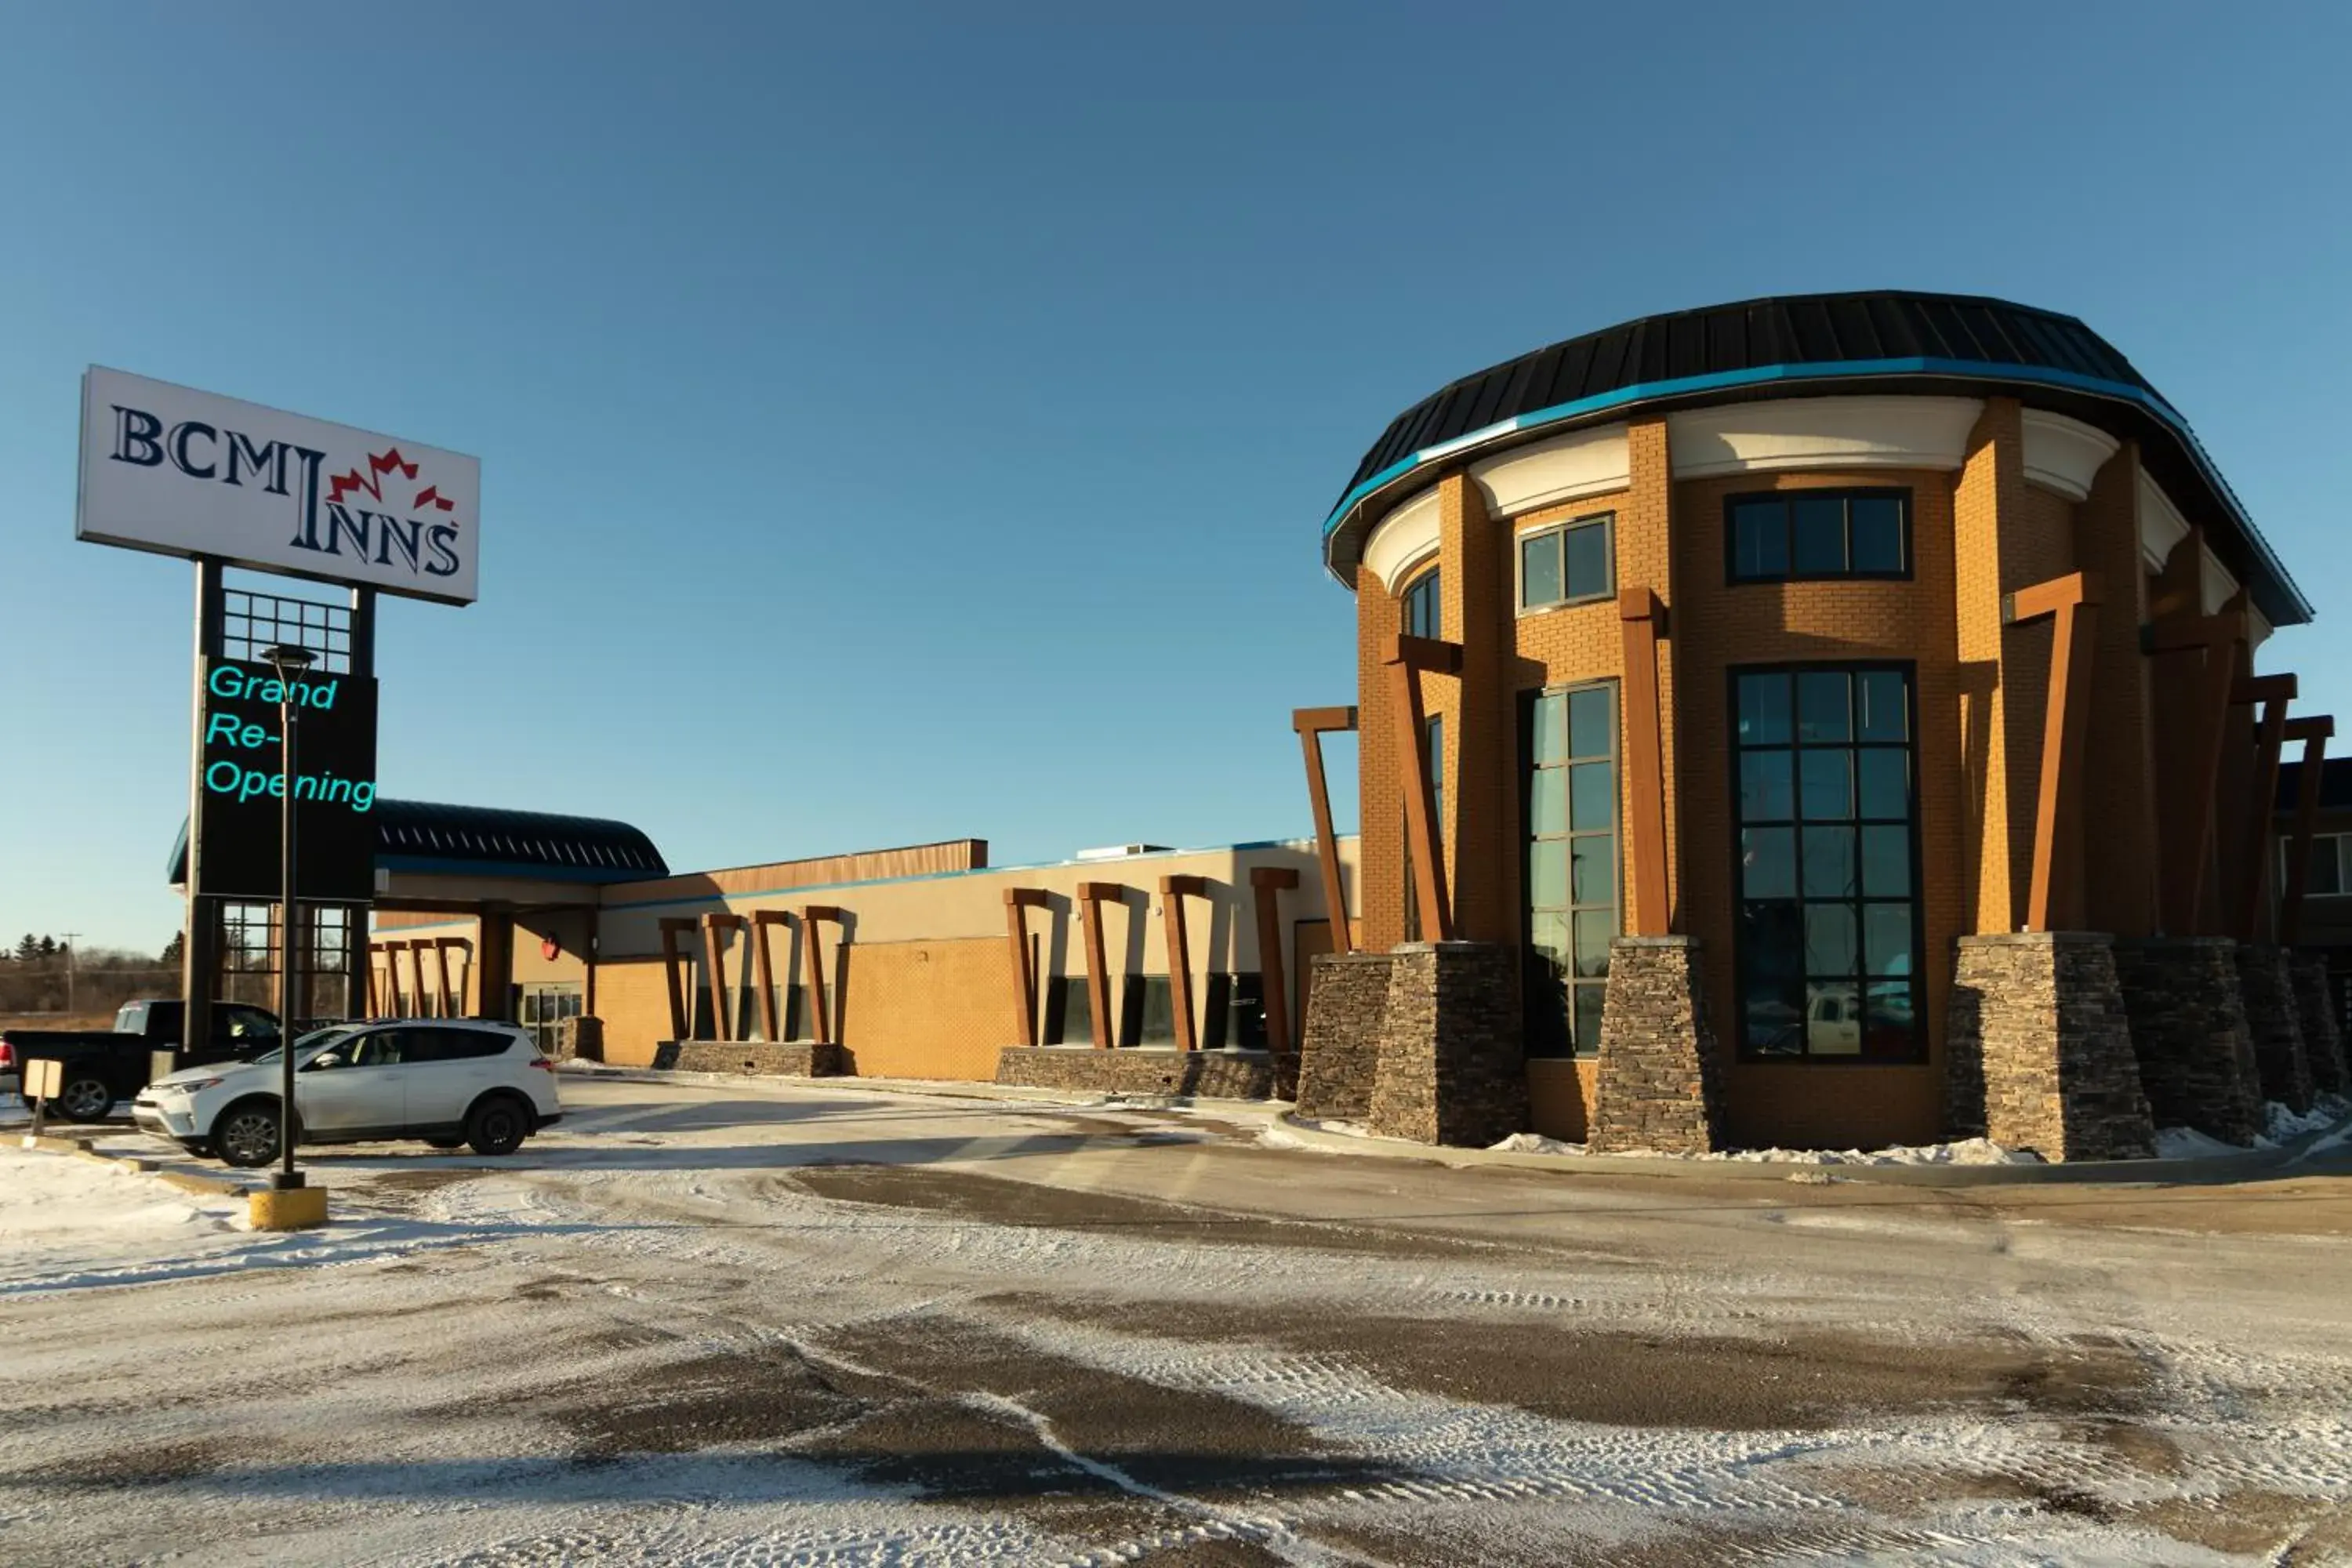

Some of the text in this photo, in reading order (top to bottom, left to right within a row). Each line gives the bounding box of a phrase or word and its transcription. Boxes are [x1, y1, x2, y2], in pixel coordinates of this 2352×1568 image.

[209, 665, 338, 710] Grand
[205, 712, 281, 748] Re-
[205, 760, 377, 812] Opening
